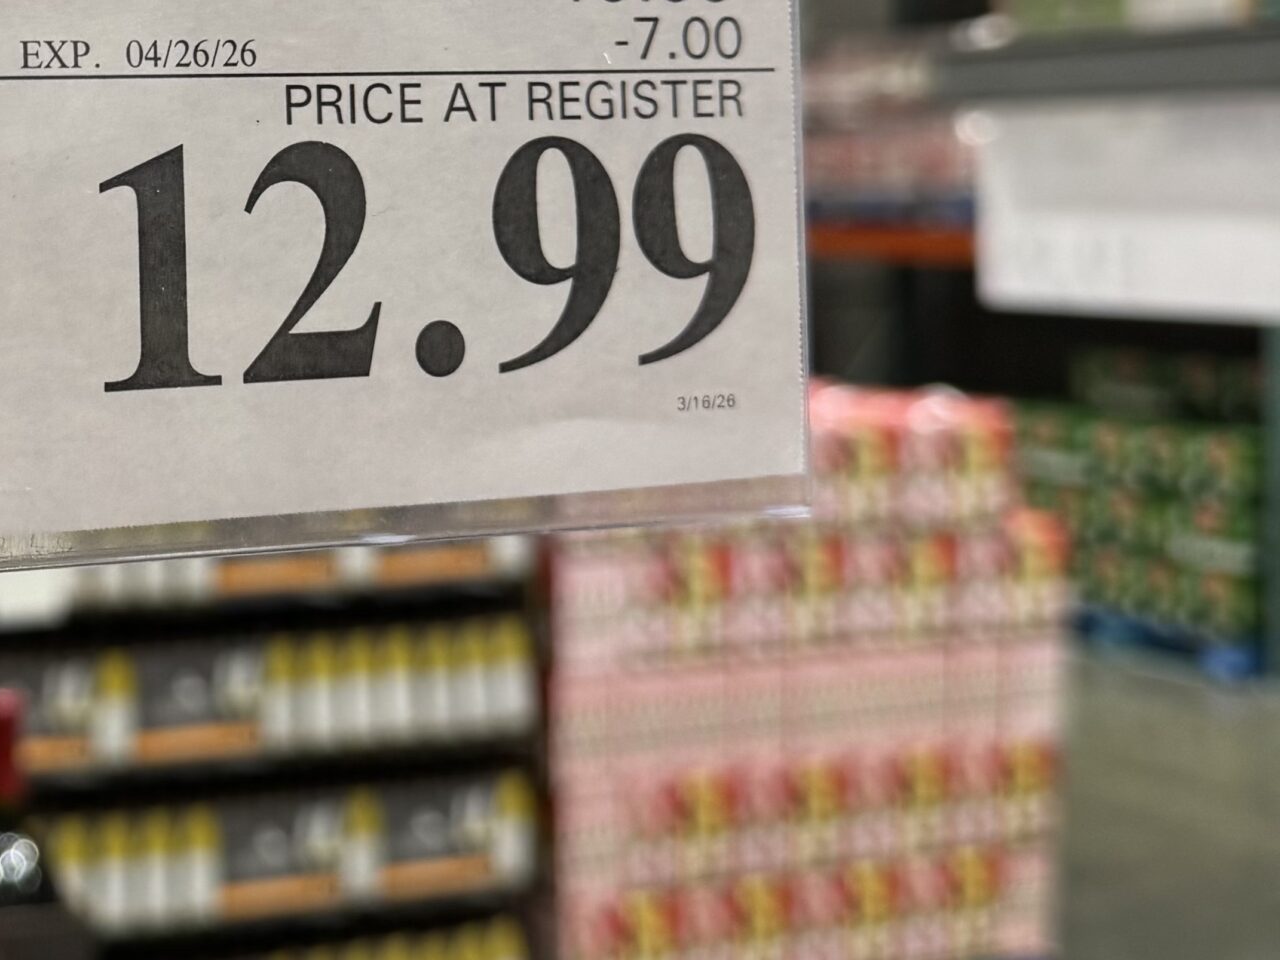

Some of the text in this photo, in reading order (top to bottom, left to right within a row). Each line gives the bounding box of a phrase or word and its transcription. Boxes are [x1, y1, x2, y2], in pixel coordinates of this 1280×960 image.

[20, 39, 257, 69] EXP. 04/26/26
[614, 16, 743, 60] -7.00
[285, 79, 744, 126] PRICE AT REGISTER
[98, 132, 756, 393] 12.99
[676, 393, 737, 412] 3/16/26
